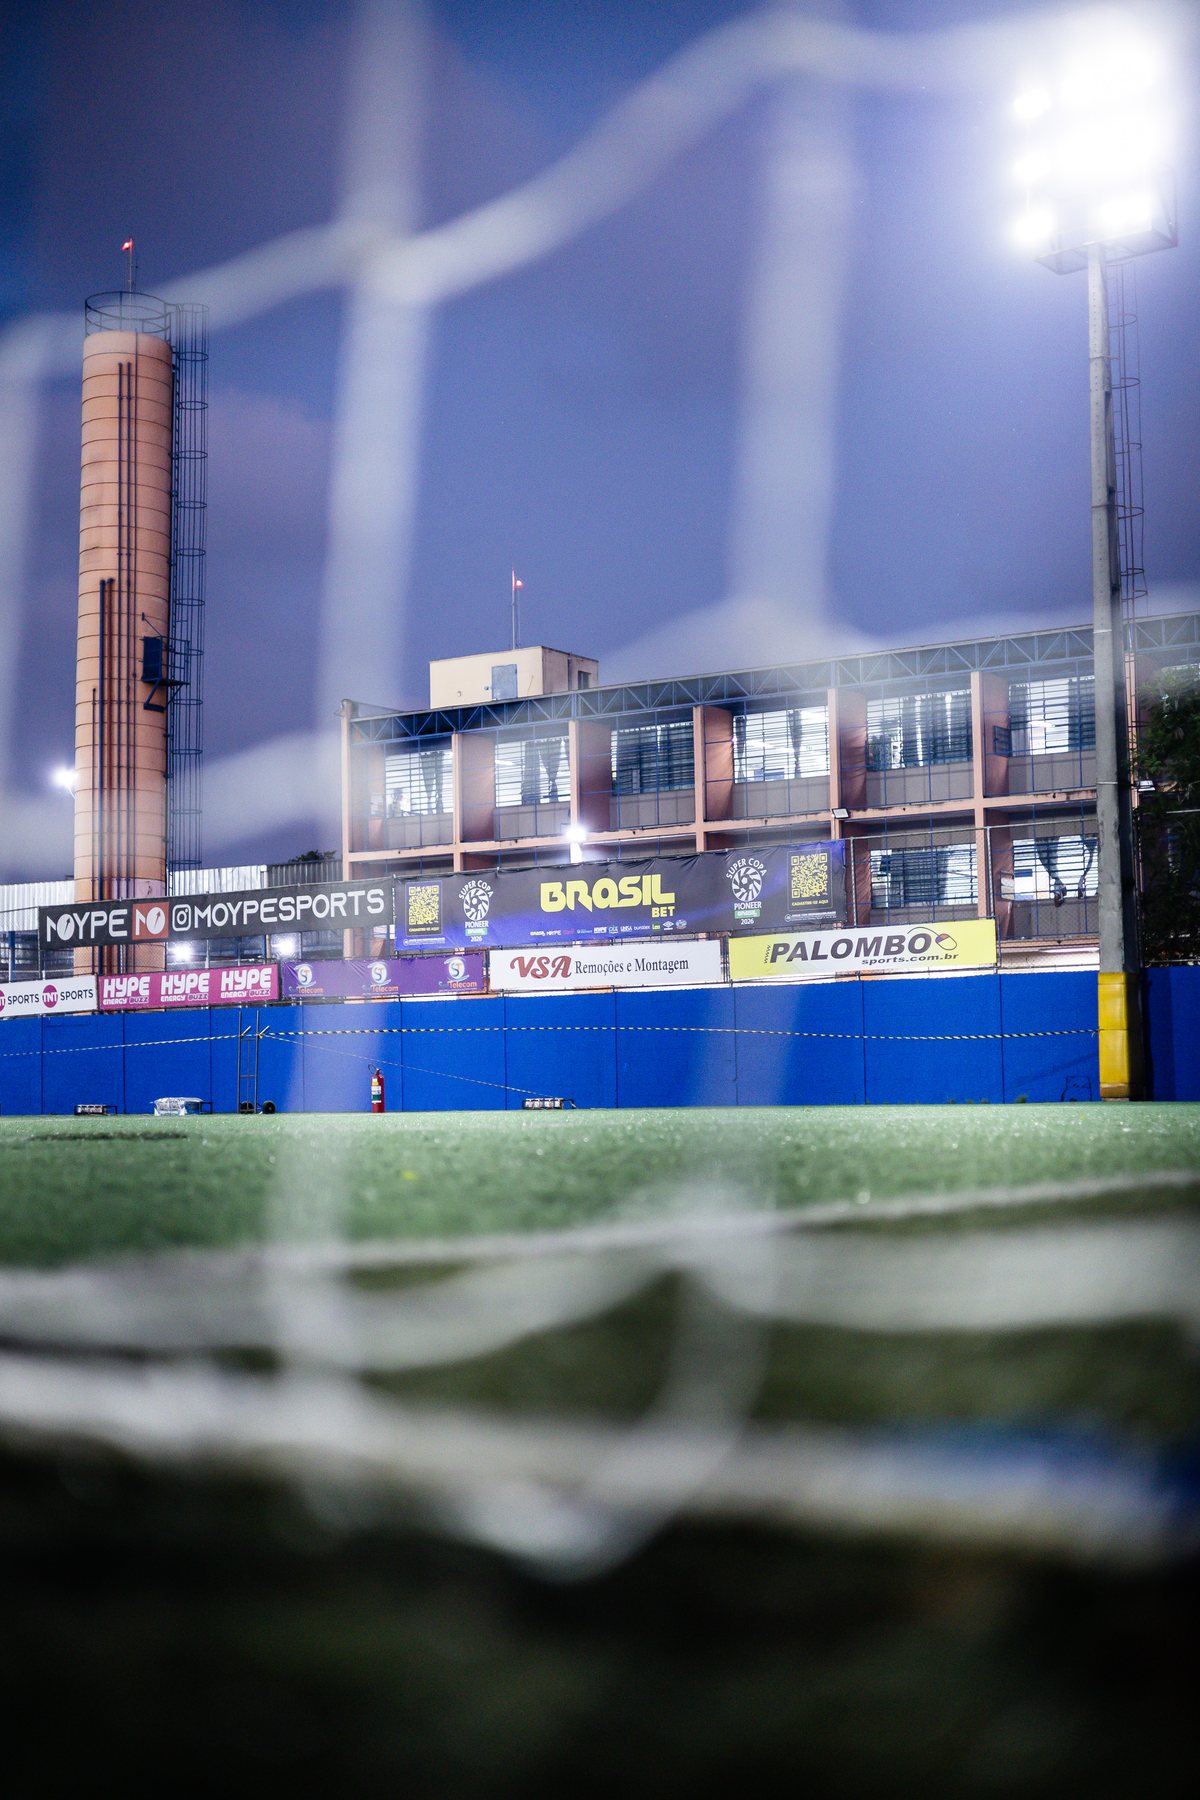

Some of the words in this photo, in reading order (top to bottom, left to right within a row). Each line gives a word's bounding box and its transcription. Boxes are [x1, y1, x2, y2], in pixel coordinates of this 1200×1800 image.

[726, 858, 747, 879] SUPER
[748, 858, 767, 876] COPA
[458, 880, 476, 899] SUPER
[477, 880, 494, 897] COPA
[540, 874, 675, 912] BRASIL
[194, 888, 385, 929] MOYPESPORTS
[651, 906, 675, 918] BET
[734, 901, 762, 910] PIONEER
[465, 920, 489, 928] PIONEER
[770, 933, 932, 963] PALOMBO
[510, 955, 572, 979] VSA
[575, 960, 624, 976] Remoções
[626, 963, 631, 971] e
[634, 958, 689, 974] Montagem
[862, 953, 959, 965] sports.com.br
[103, 976, 150, 998] HYPE
[160, 973, 210, 995] HYPE
[220, 968, 272, 991] HYPE
[7, 993, 39, 1005] SPORTS
[42, 992, 58, 1003] TNT
[60, 989, 94, 1001] SPORTS
[102, 997, 127, 1005] ENERGY
